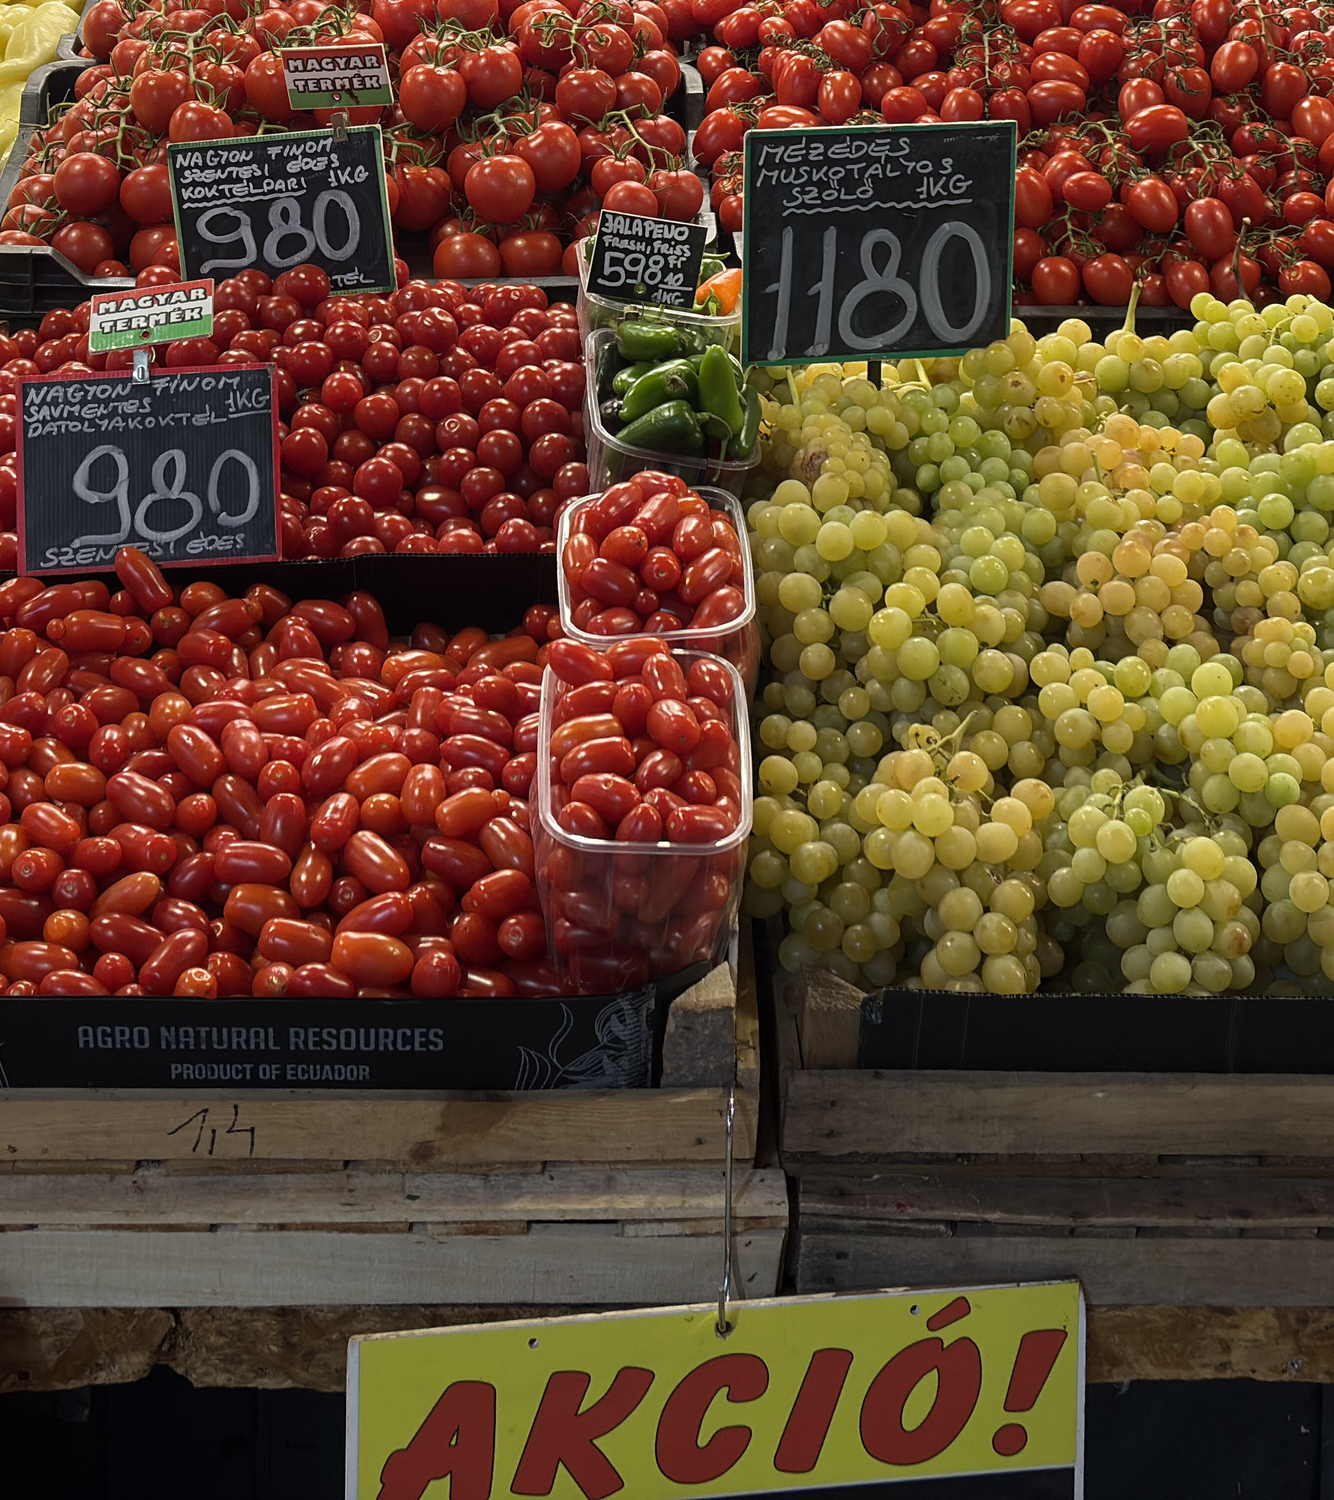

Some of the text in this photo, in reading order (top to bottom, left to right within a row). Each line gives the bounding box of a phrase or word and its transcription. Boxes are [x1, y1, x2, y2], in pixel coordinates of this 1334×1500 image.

[287, 55, 380, 73] MAGYAR
[294, 74, 381, 93] TERMÉK
[175, 138, 334, 168] NAGYON FINOM
[180, 153, 340, 184] SZENTESI ÉDES
[181, 166, 369, 200] KOKTÉLPARI 1KG
[916, 174, 973, 199] 1KG
[196, 189, 360, 274] 980
[601, 214, 689, 241] JALAPENO
[597, 251, 664, 286] 598
[97, 287, 207, 315] MAGYAR
[763, 221, 991, 361] 1180
[100, 308, 203, 333] TERMÉK
[24, 388, 270, 422] SAVMENTES 1KG
[25, 375, 240, 405] NAGYON FINOM
[27, 404, 227, 438] DATOLYAKOKTÉL
[73, 444, 260, 548] 980
[186, 531, 246, 554] ÉDES
[77, 1026, 445, 1051] AGRO NATURAL RESOURCES
[171, 1063, 370, 1080] PRODUCT OF ECUADOR
[376, 1296, 1069, 1500] AKCIÓ!
